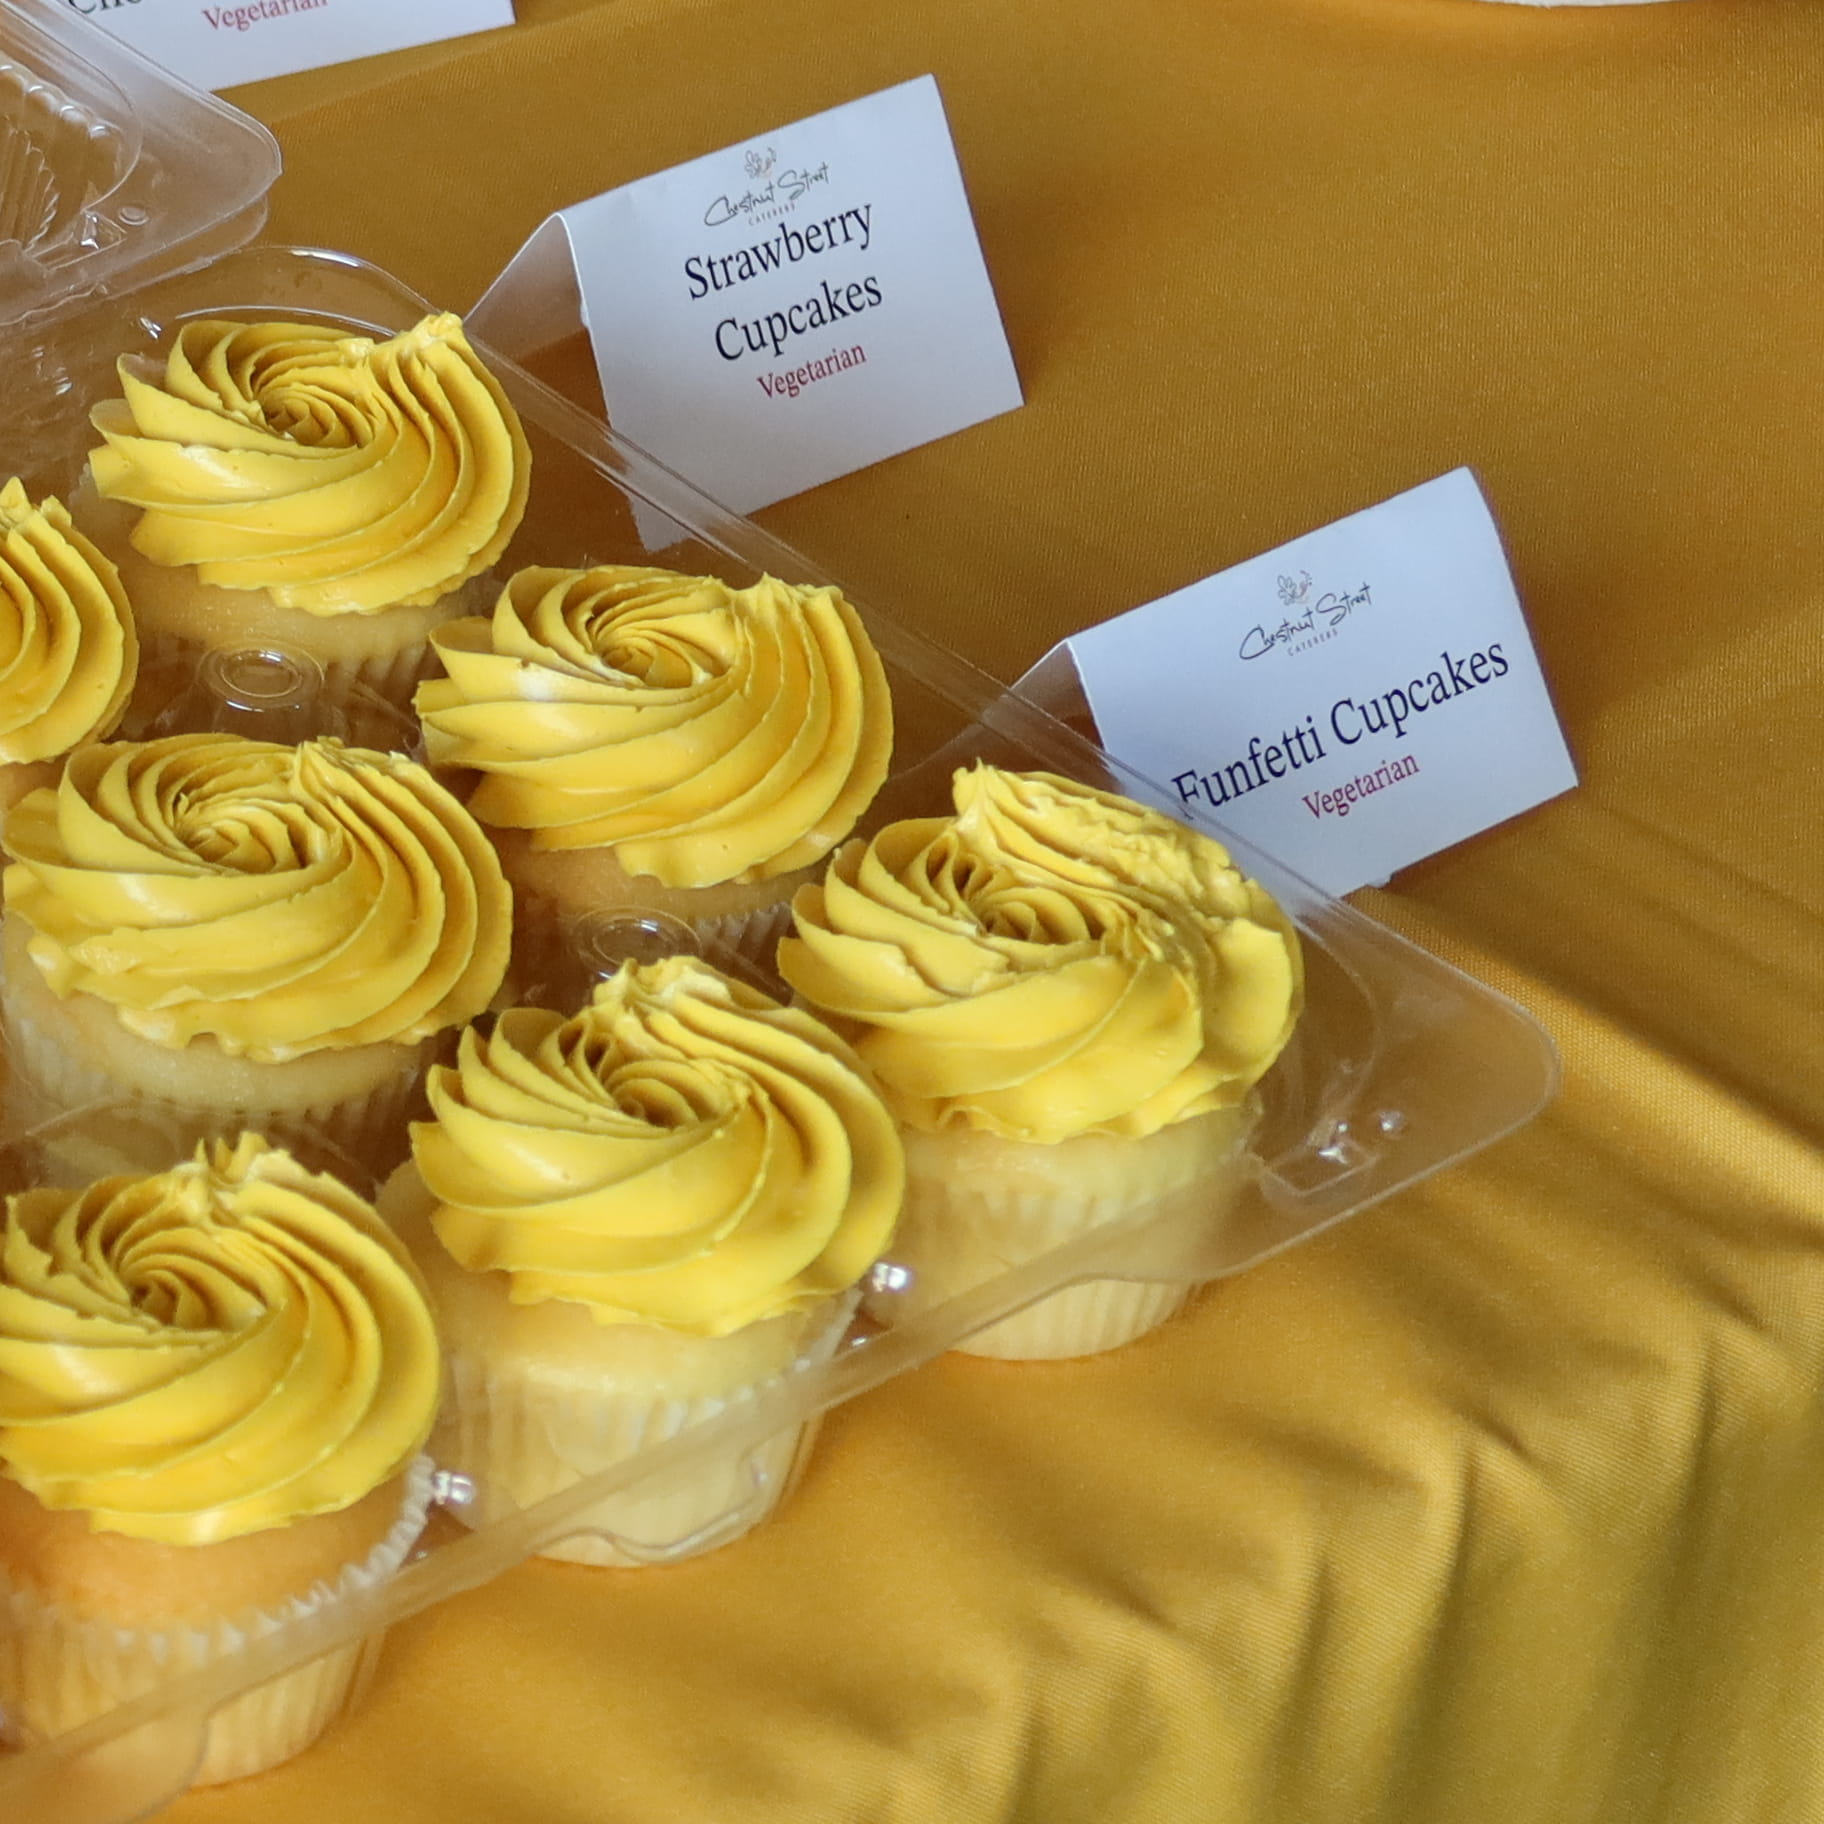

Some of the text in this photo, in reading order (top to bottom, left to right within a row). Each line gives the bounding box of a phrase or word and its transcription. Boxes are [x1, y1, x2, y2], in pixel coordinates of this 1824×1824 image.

[684, 203, 874, 301] Strawberry
[714, 275, 883, 361] Cupcakes
[757, 343, 867, 400] Vegetarian
[1170, 642, 1509, 819] Funfetti Cupcakes
[1301, 754, 1421, 821] Vegetarian
